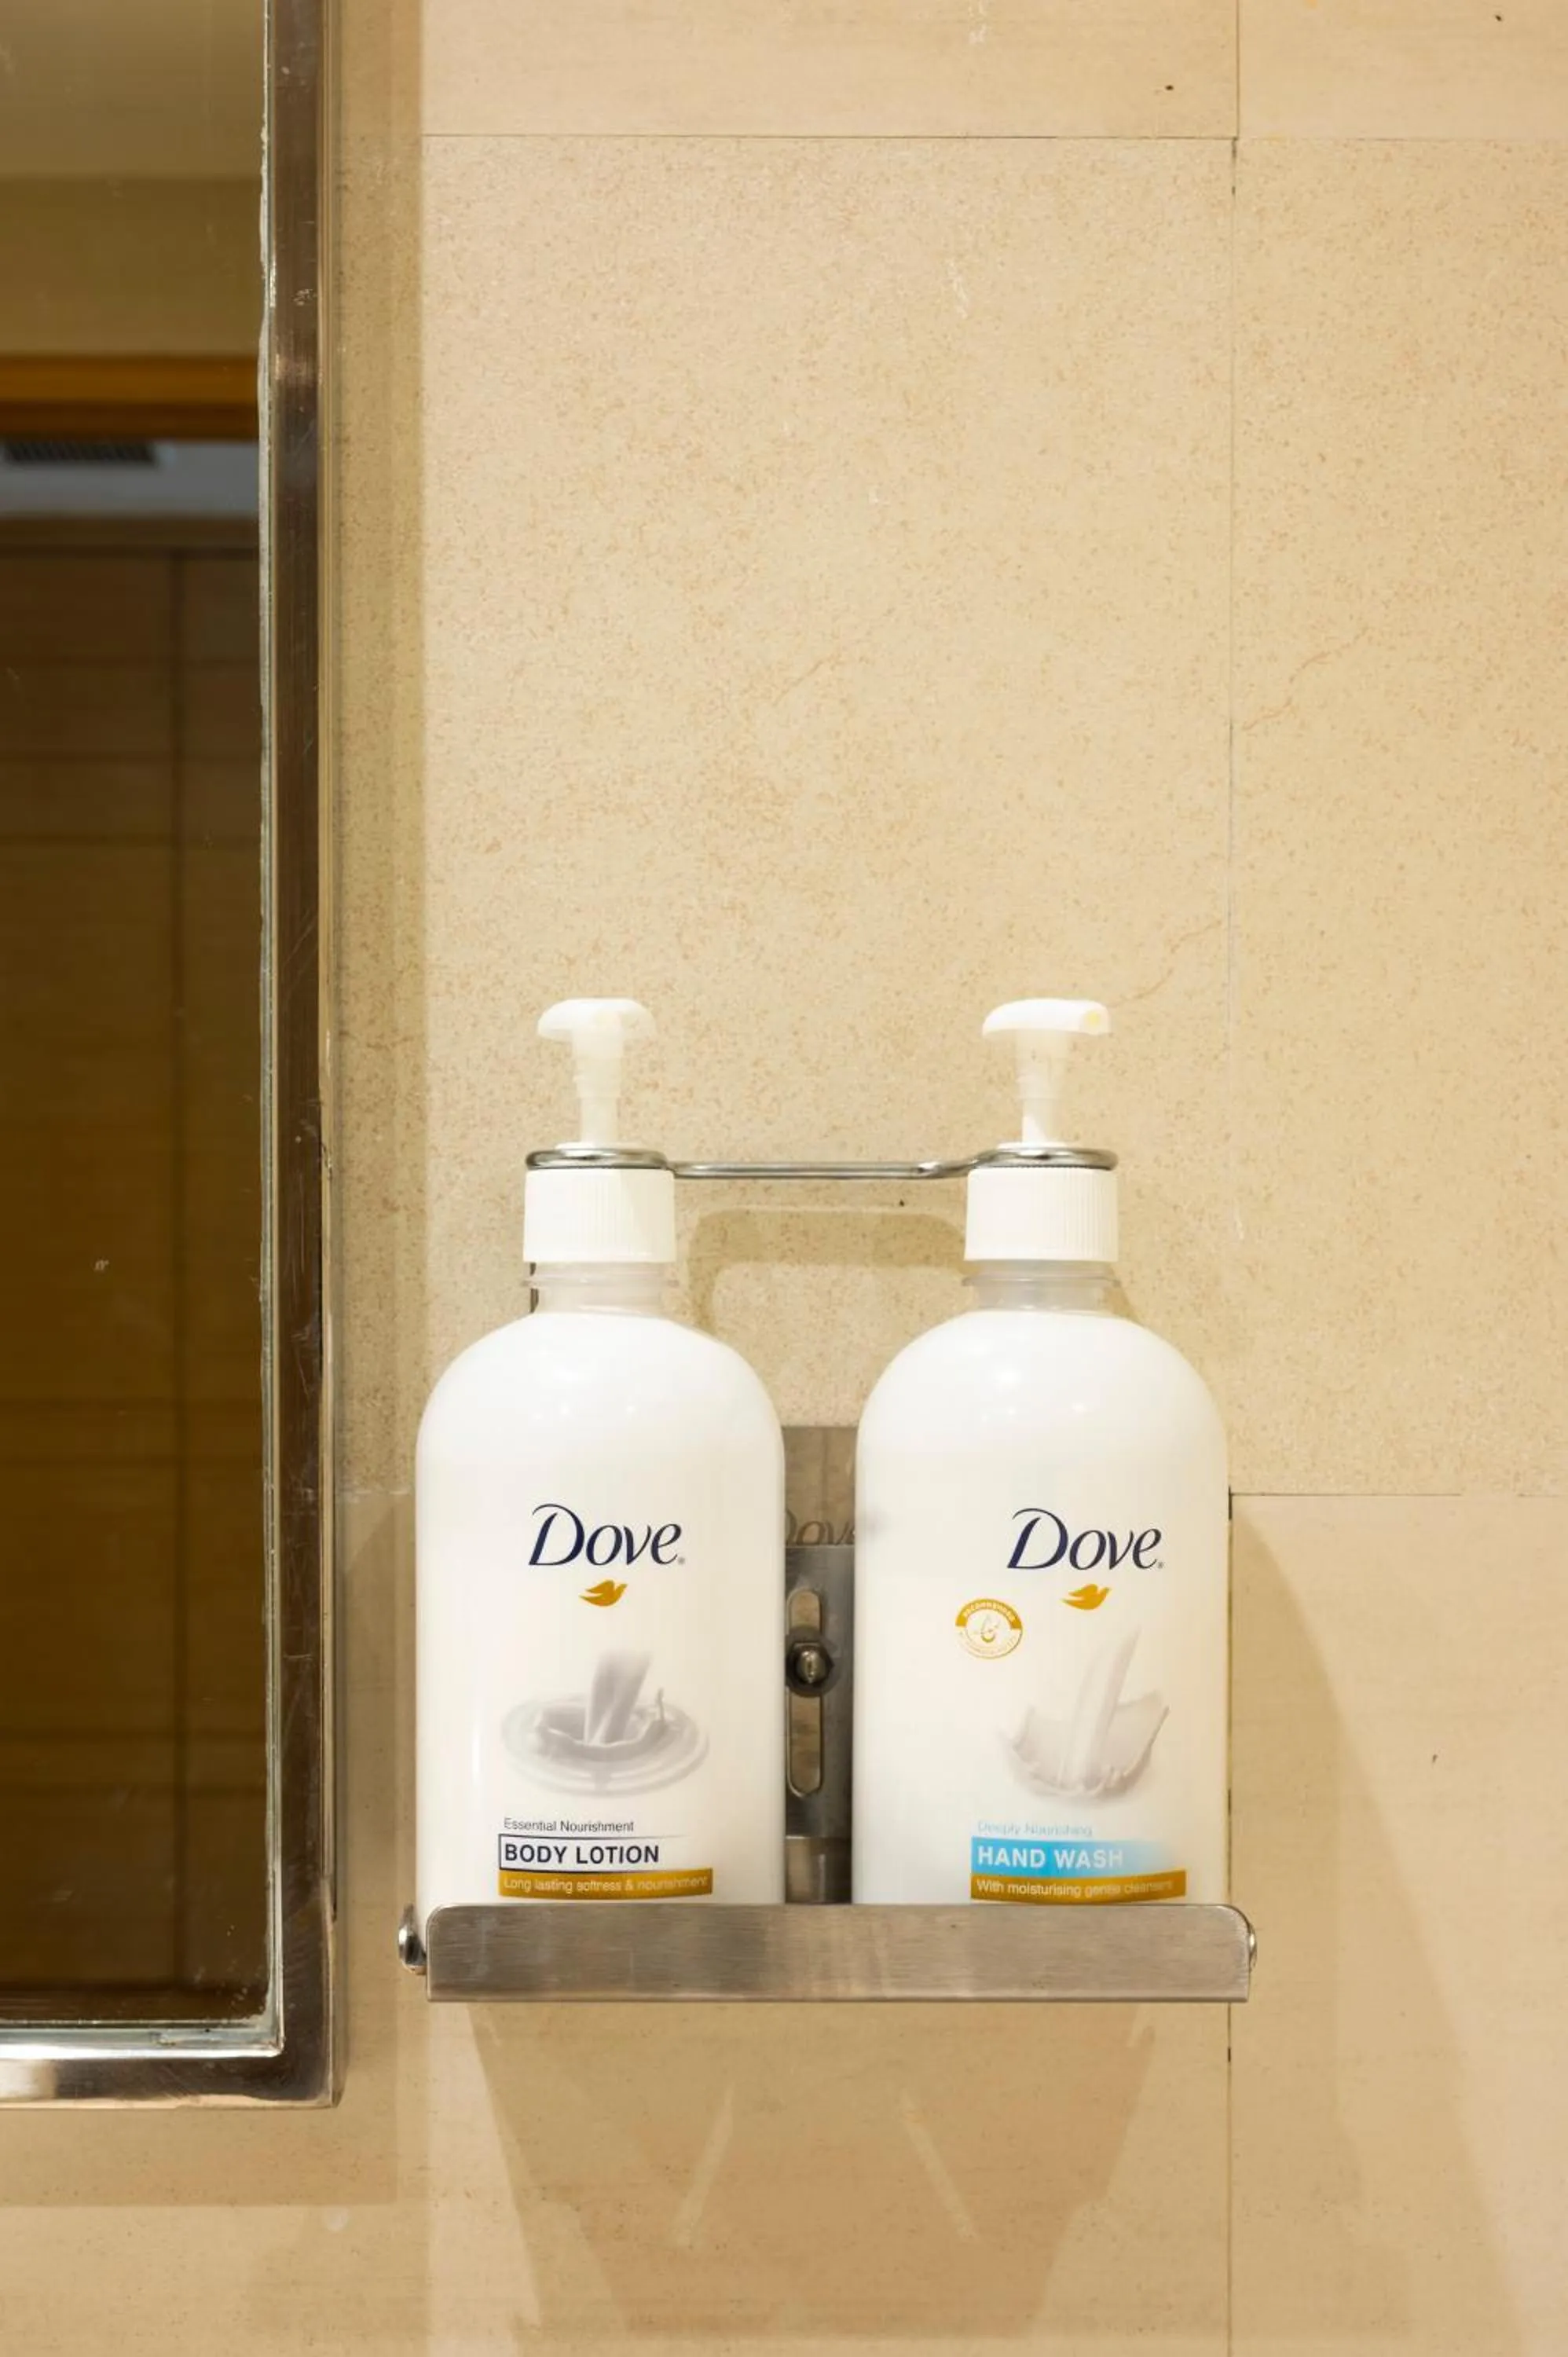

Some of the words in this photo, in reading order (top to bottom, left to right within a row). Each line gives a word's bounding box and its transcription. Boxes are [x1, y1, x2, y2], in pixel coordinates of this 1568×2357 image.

[528, 1502, 682, 1567] Dove
[1006, 1508, 1162, 1571] Dove
[504, 1818, 557, 1831] Essential
[560, 1820, 634, 1832] Nourishment
[1024, 1823, 1093, 1837] Nourishing
[505, 1844, 567, 1863] BODY
[576, 1846, 659, 1864] LOTION
[977, 1846, 1046, 1868] HAND
[1053, 1849, 1123, 1868] WASH
[504, 1878, 532, 1890] Long
[534, 1879, 573, 1894] lasting
[576, 1879, 622, 1891] softness
[625, 1879, 634, 1890] &
[637, 1875, 708, 1890] nourishment
[977, 1879, 1004, 1893] With
[1007, 1882, 1081, 1897] moisturising
